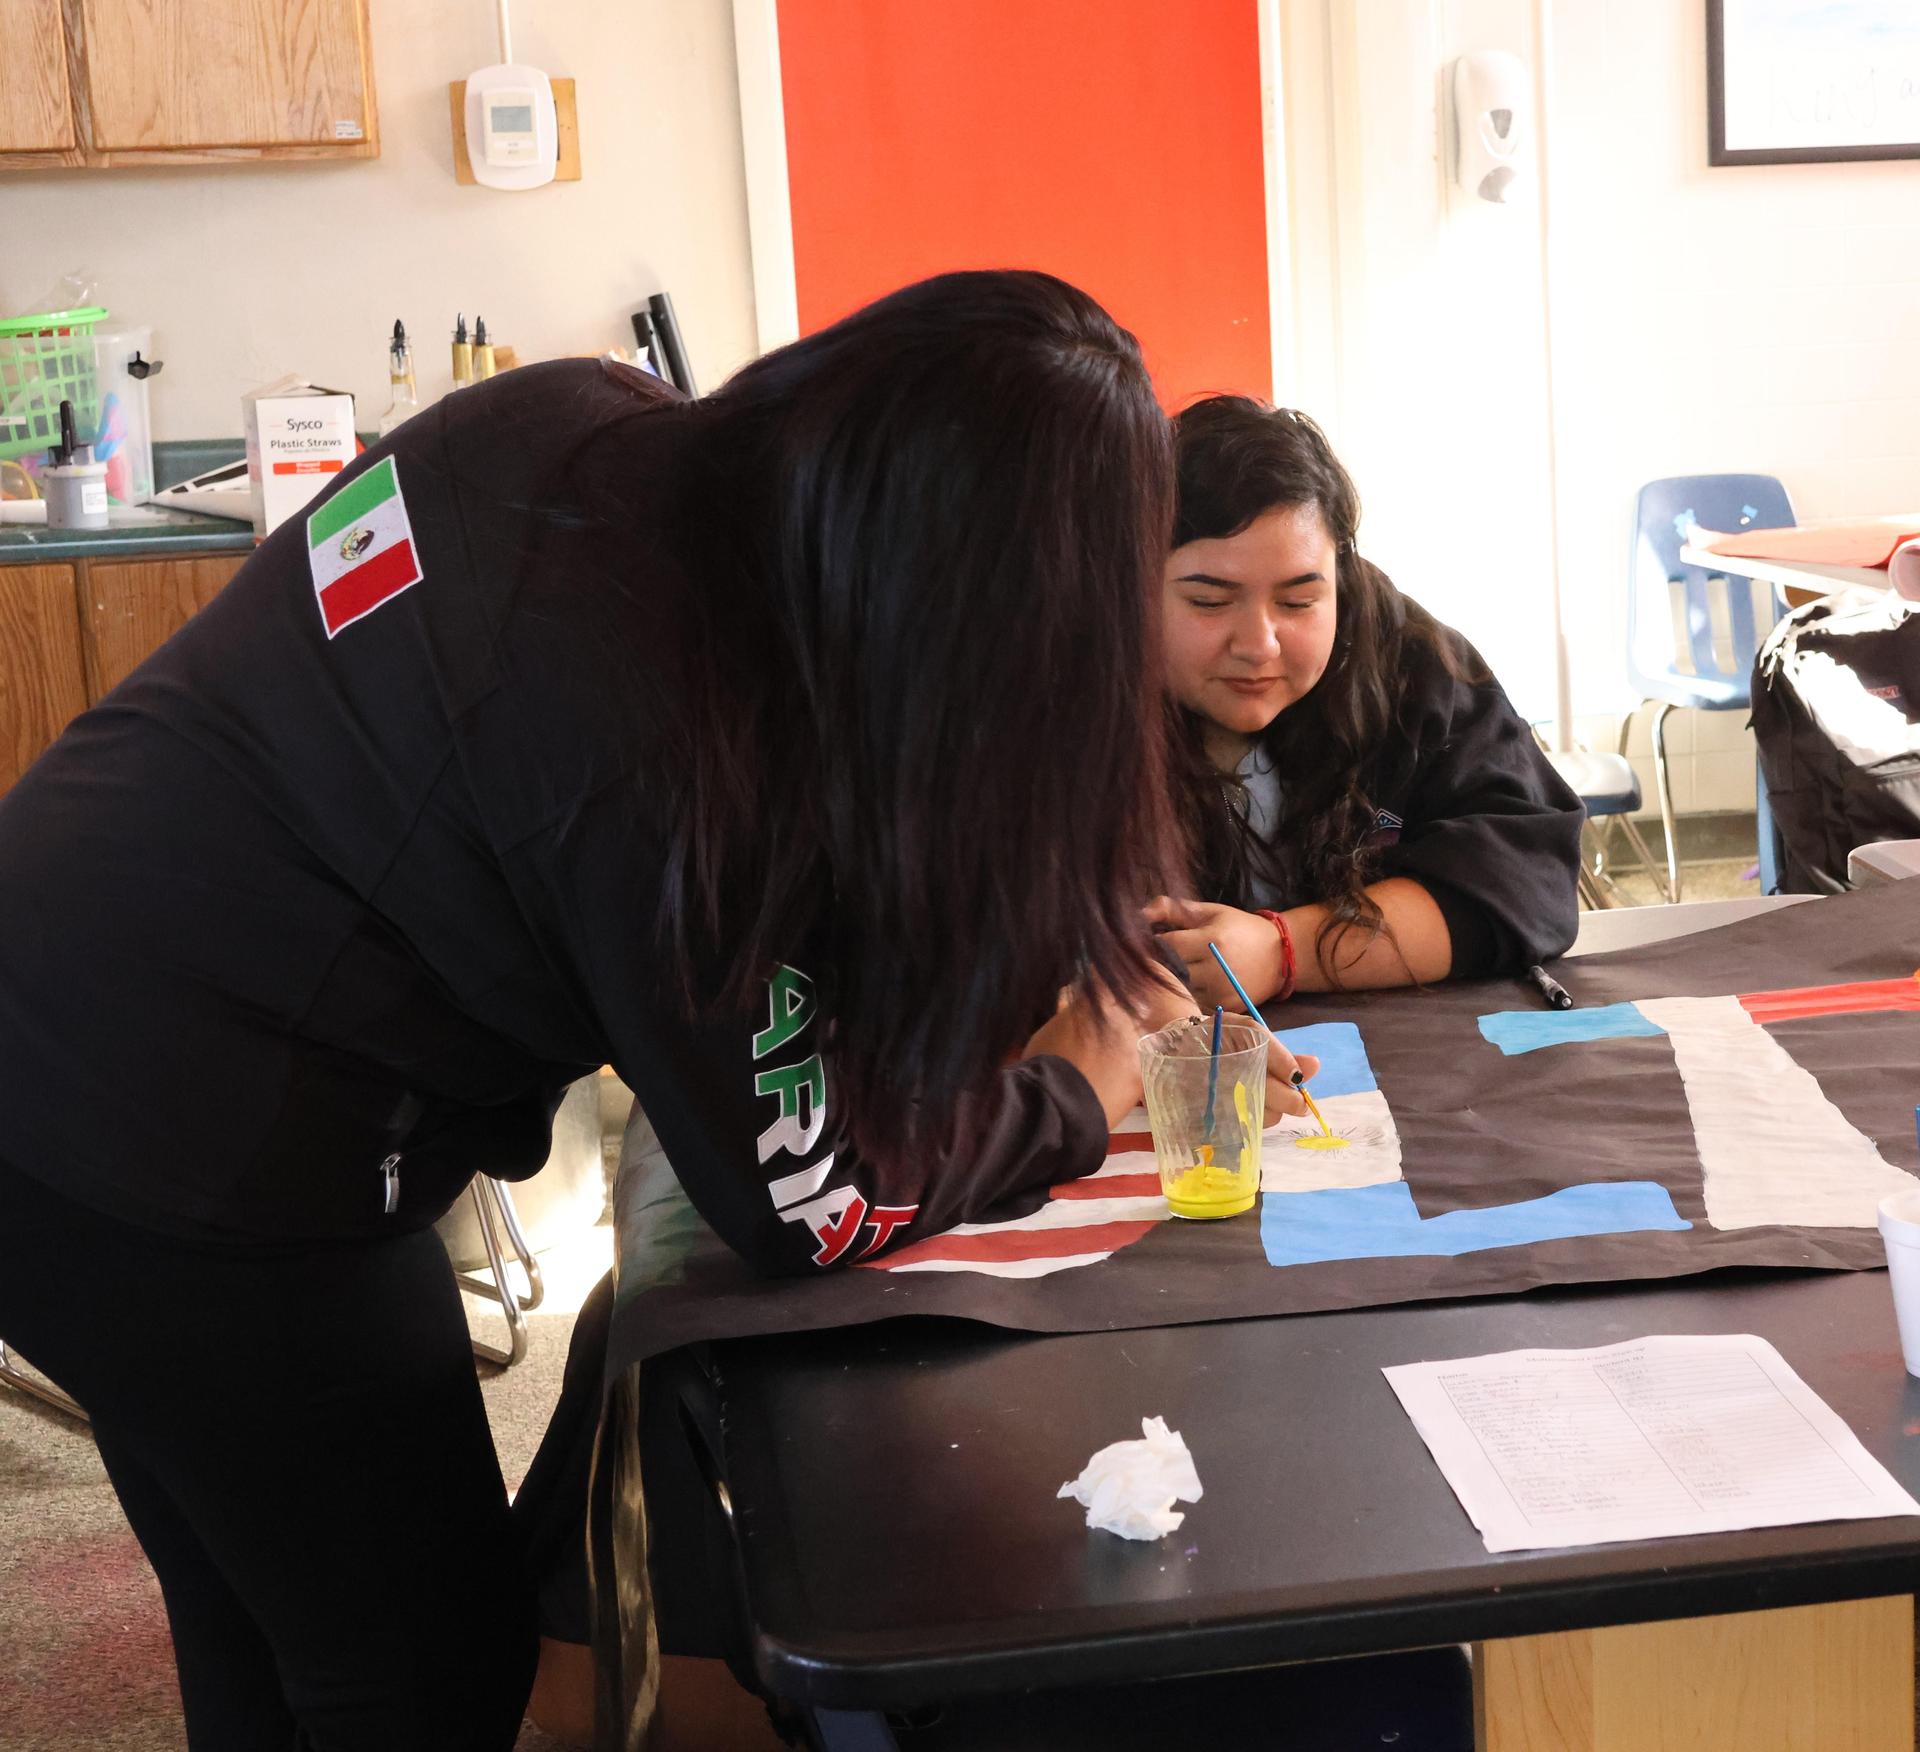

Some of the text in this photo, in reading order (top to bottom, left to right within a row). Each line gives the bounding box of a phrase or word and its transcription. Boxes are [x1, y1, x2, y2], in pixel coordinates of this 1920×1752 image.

[286, 418, 323, 432] Sysco
[270, 438, 342, 449] Plastic Straws
[752, 963, 920, 1267] ARIAT
